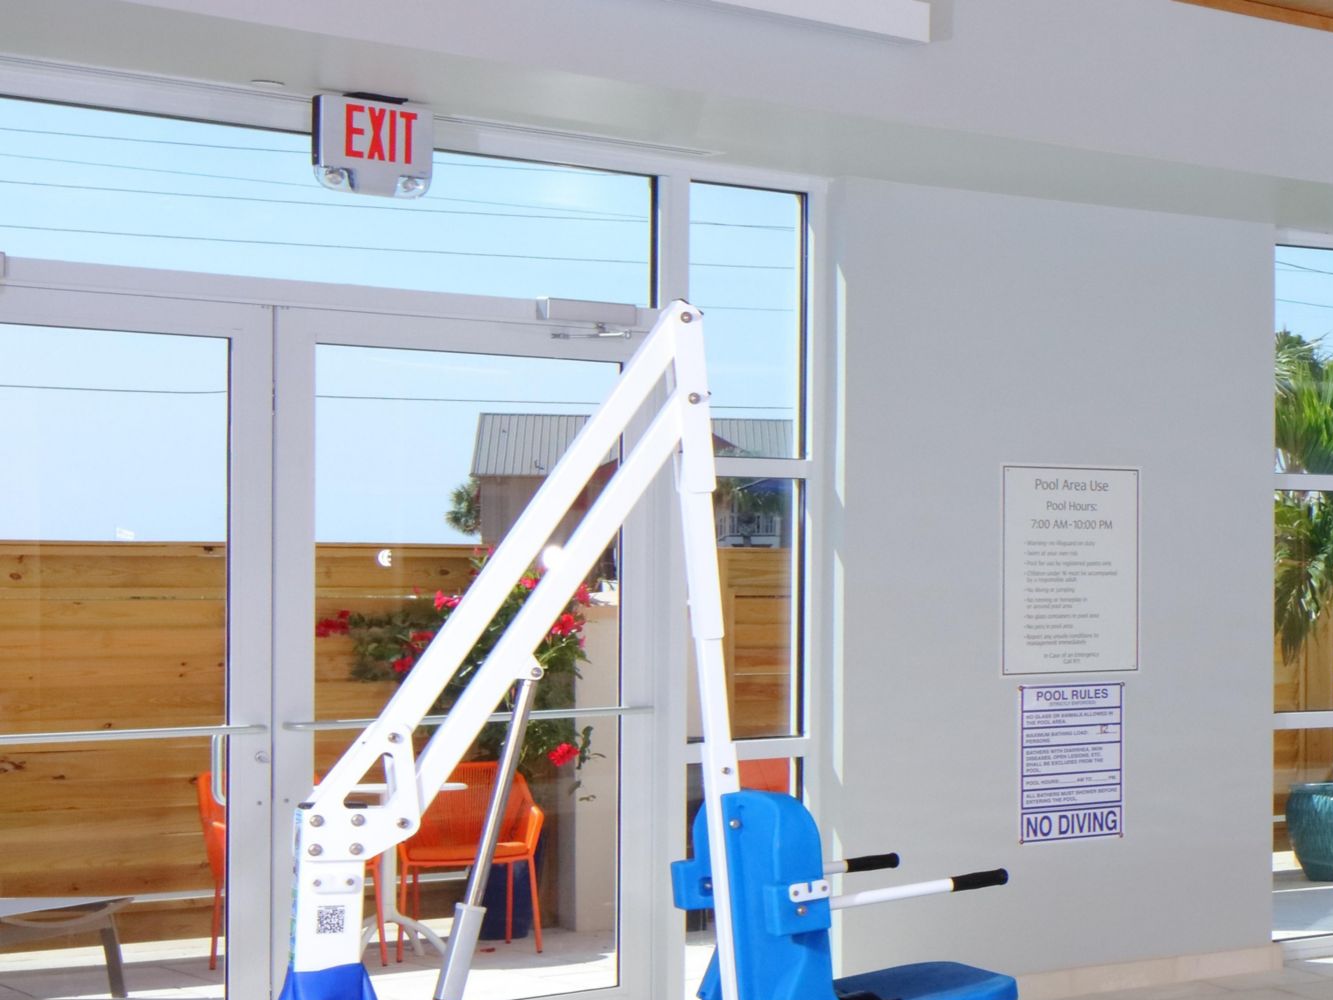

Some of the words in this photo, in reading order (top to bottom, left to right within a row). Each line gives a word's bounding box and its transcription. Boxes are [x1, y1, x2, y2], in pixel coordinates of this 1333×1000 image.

[345, 103, 418, 165] EXIT
[1034, 478, 1059, 490] Pool
[1062, 479, 1087, 491] Area
[1089, 480, 1109, 492] Use
[1046, 500, 1067, 511] Pool
[1068, 501, 1098, 512] Hours:
[1031, 519, 1051, 529] 7:00
[1098, 520, 1113, 530] PM
[1036, 690, 1069, 701] POOL
[1071, 688, 1109, 700] RULES
[1026, 815, 1052, 838] NO
[1058, 810, 1118, 835] DIVING
